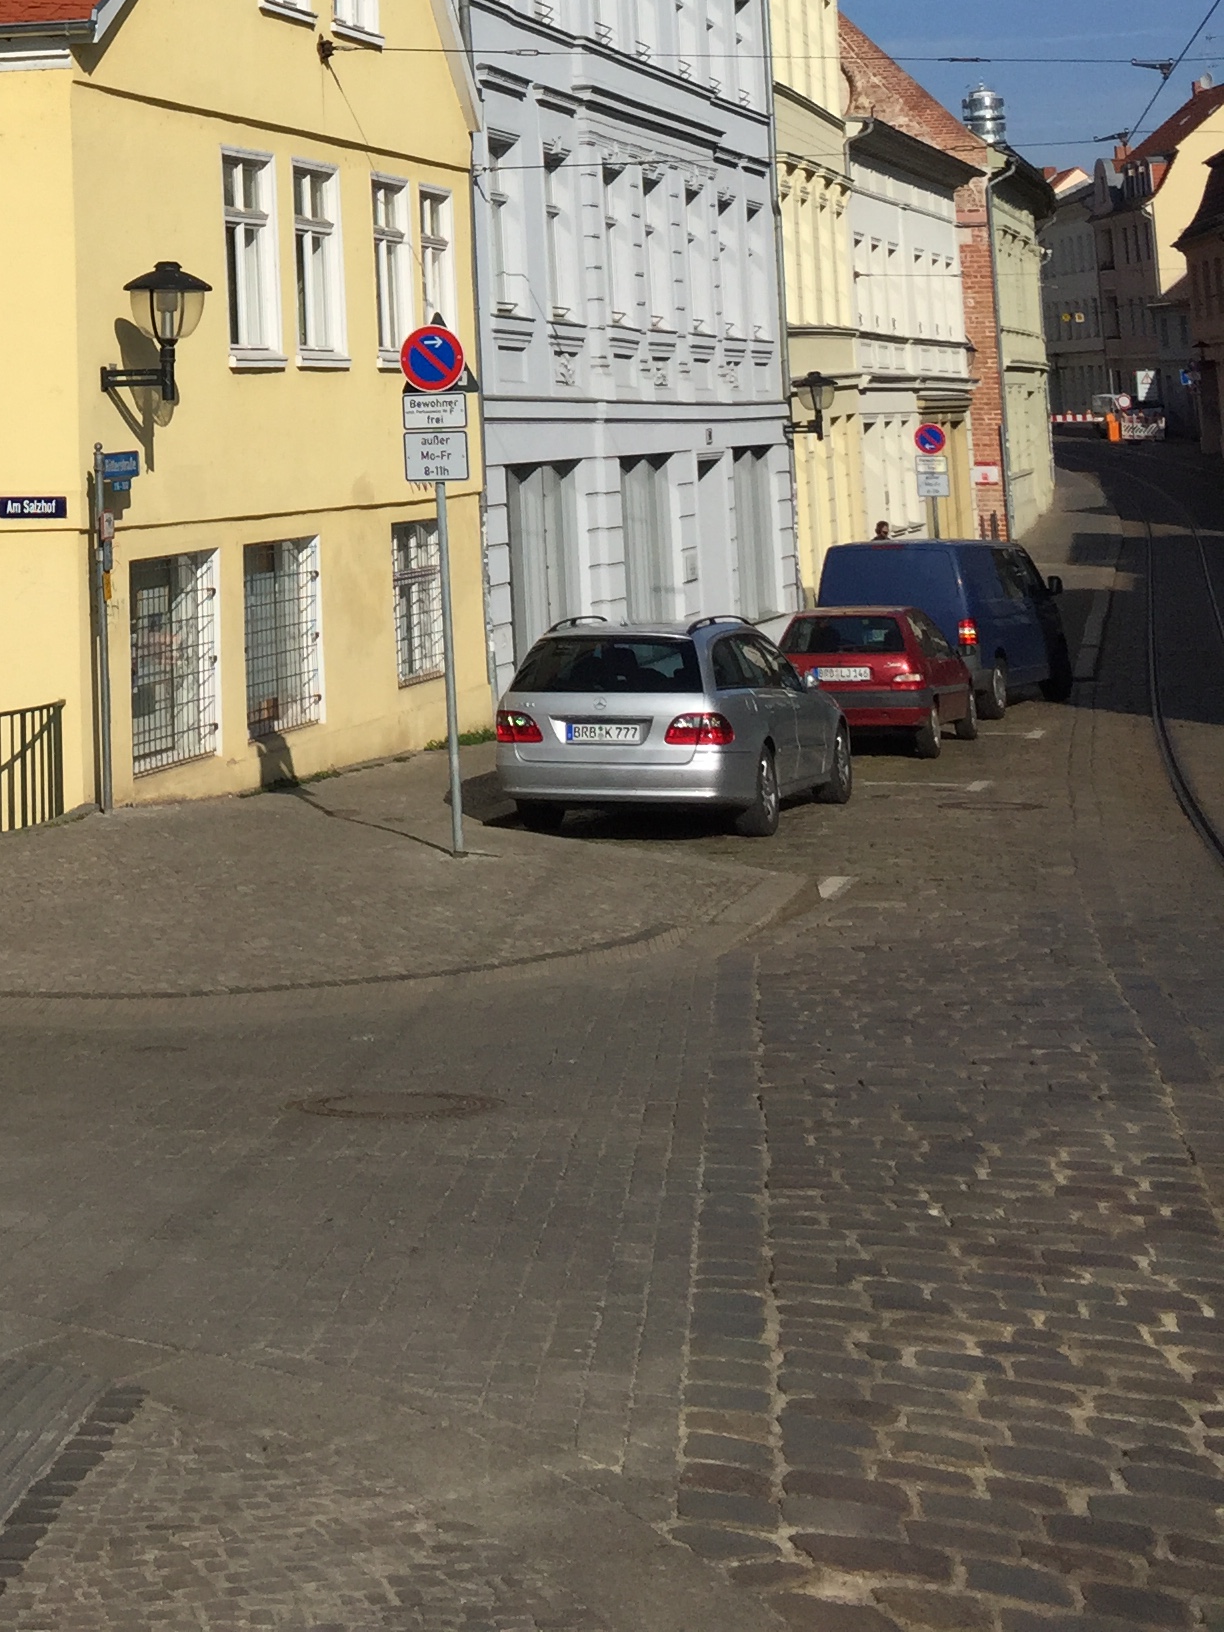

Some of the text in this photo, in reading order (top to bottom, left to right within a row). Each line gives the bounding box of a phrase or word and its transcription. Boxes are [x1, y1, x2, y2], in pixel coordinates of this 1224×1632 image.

[409, 399, 459, 408] Bewohner
[426, 415, 444, 424] frei
[420, 435, 451, 446] außer
[420, 450, 452, 461] Mo-Fr
[6, 499, 56, 514] Am Salzhof
[573, 726, 638, 739] BRB K 777
